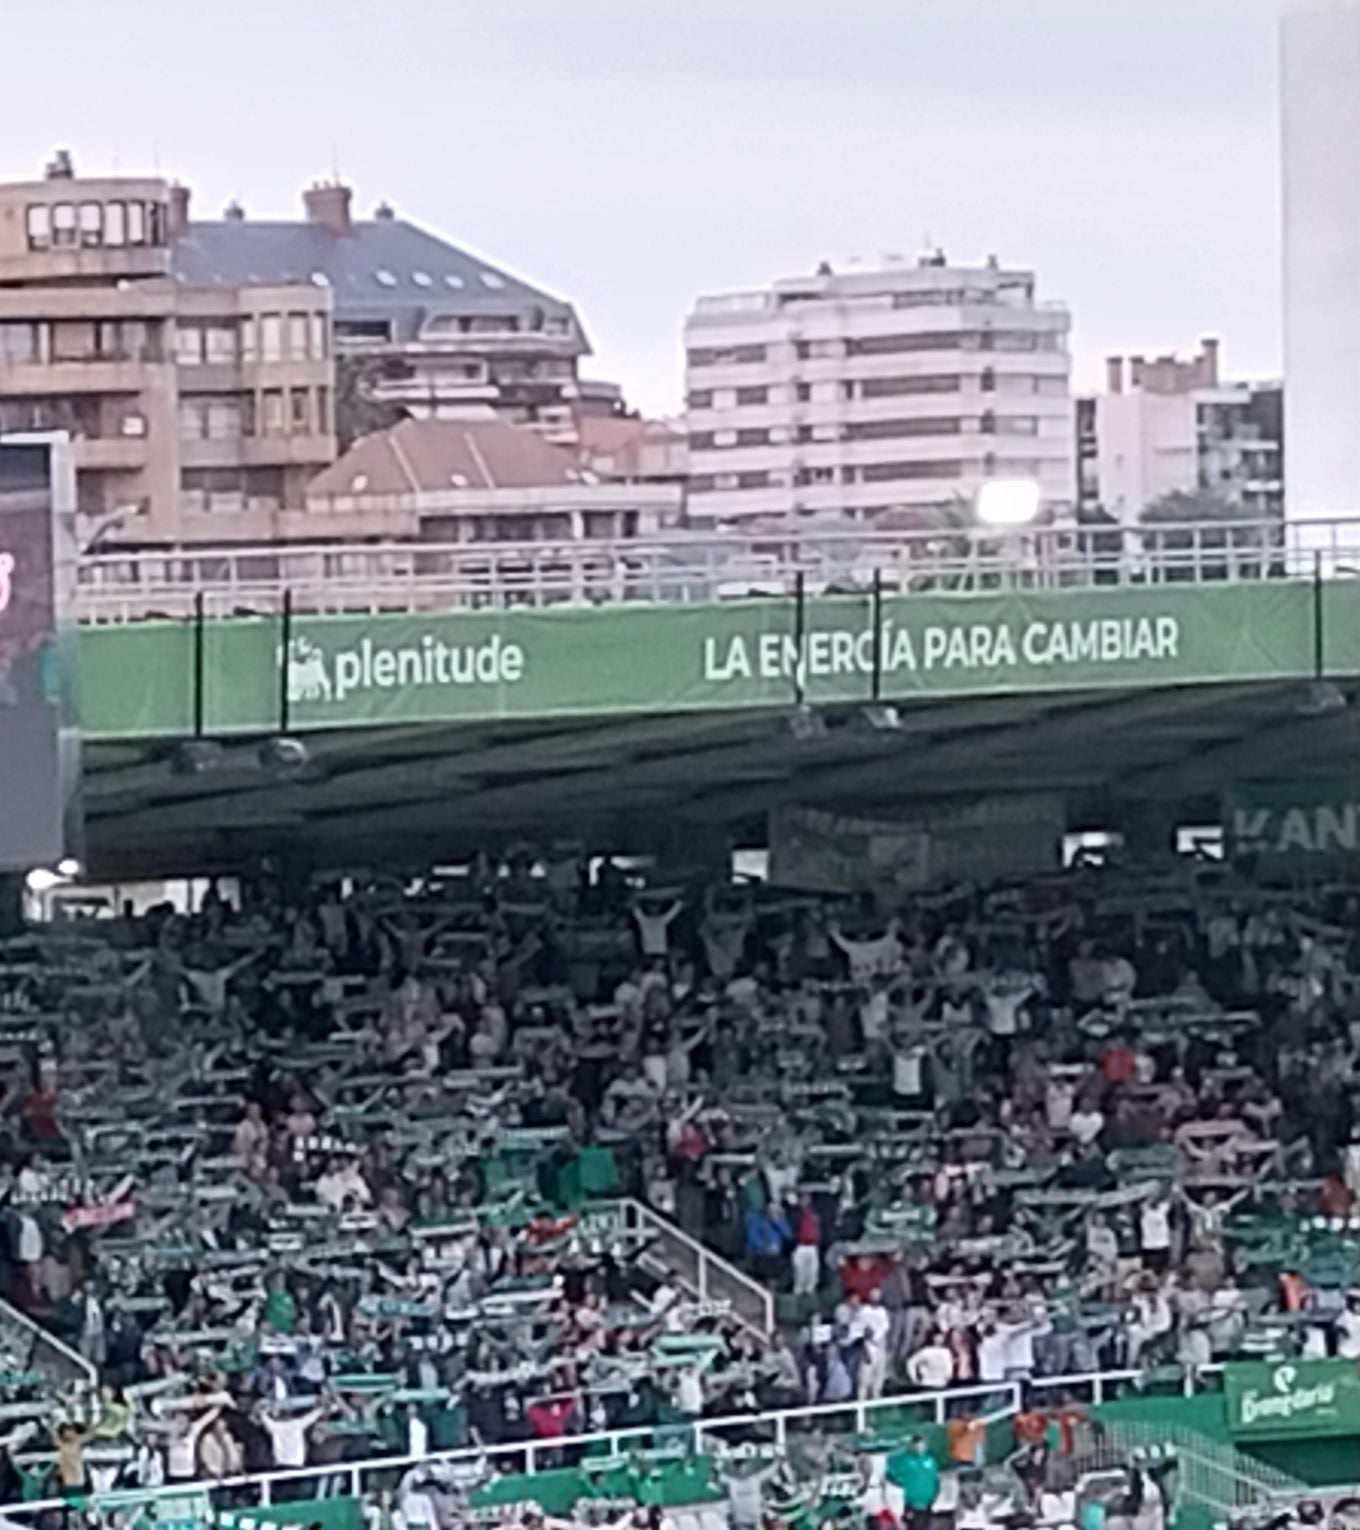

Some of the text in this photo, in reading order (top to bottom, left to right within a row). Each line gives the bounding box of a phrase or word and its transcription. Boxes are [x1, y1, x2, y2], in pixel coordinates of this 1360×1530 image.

[335, 633, 525, 702] plenitude
[705, 635, 752, 680] LA
[923, 624, 1018, 670] PARA
[1021, 615, 1179, 664] CAMBIAR
